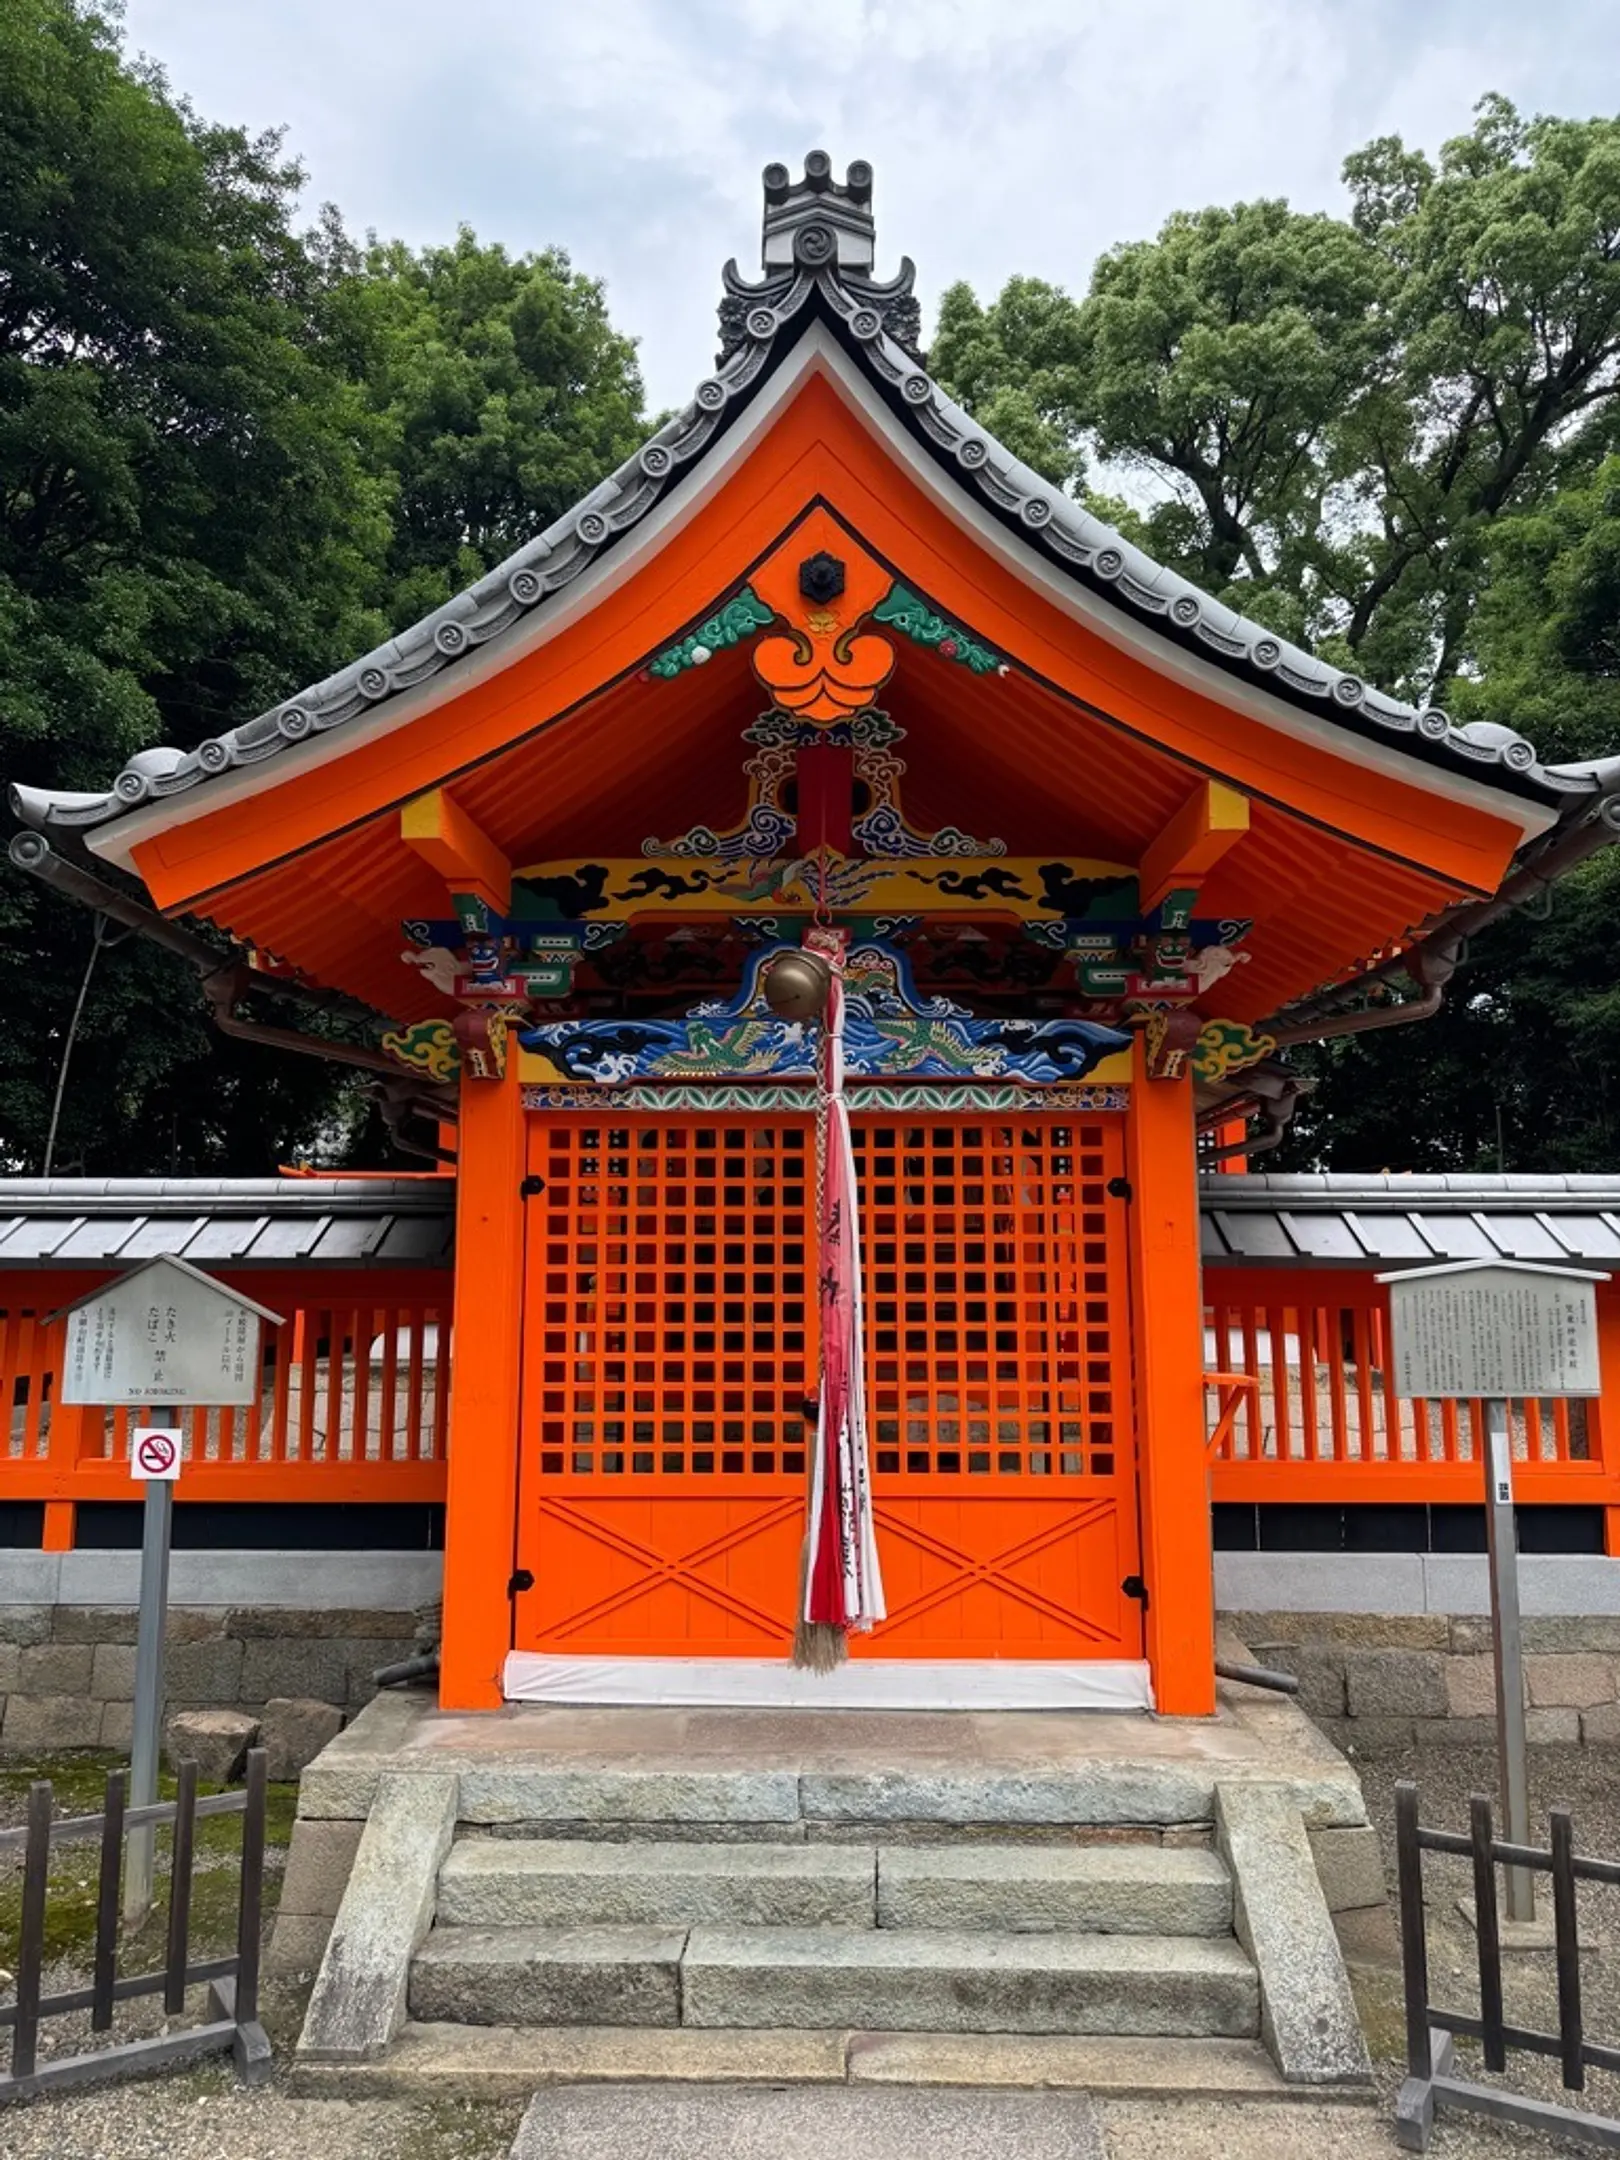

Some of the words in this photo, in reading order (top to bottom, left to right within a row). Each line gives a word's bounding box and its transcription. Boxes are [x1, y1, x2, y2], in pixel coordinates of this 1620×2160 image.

[147, 1306, 160, 1343] たばこ
[164, 1306, 177, 1343] たき火
[153, 1349, 166, 1381] 禁止
